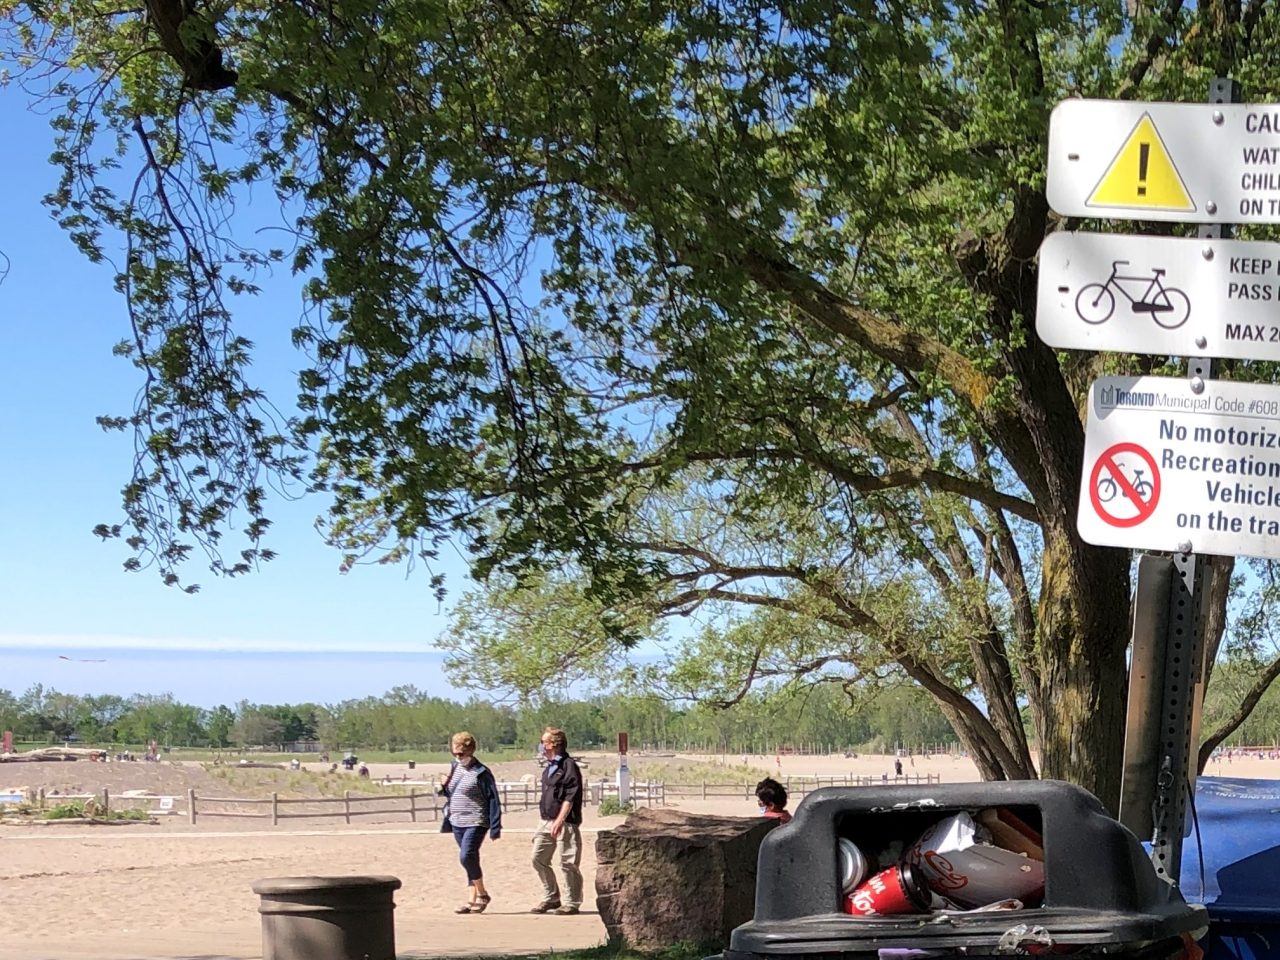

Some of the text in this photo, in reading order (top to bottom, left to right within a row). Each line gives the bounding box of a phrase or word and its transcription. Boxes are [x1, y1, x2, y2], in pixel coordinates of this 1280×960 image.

[1239, 199, 1263, 216] ON
[1229, 257, 1272, 275] KEEP
[1228, 282, 1273, 301] PASS
[1225, 323, 1266, 342] MAX
[1115, 387, 1279, 416] TORONTO Municipal Code #608
[1159, 419, 1188, 441] No
[1176, 513, 1201, 529] on
[1207, 510, 1243, 533] the
